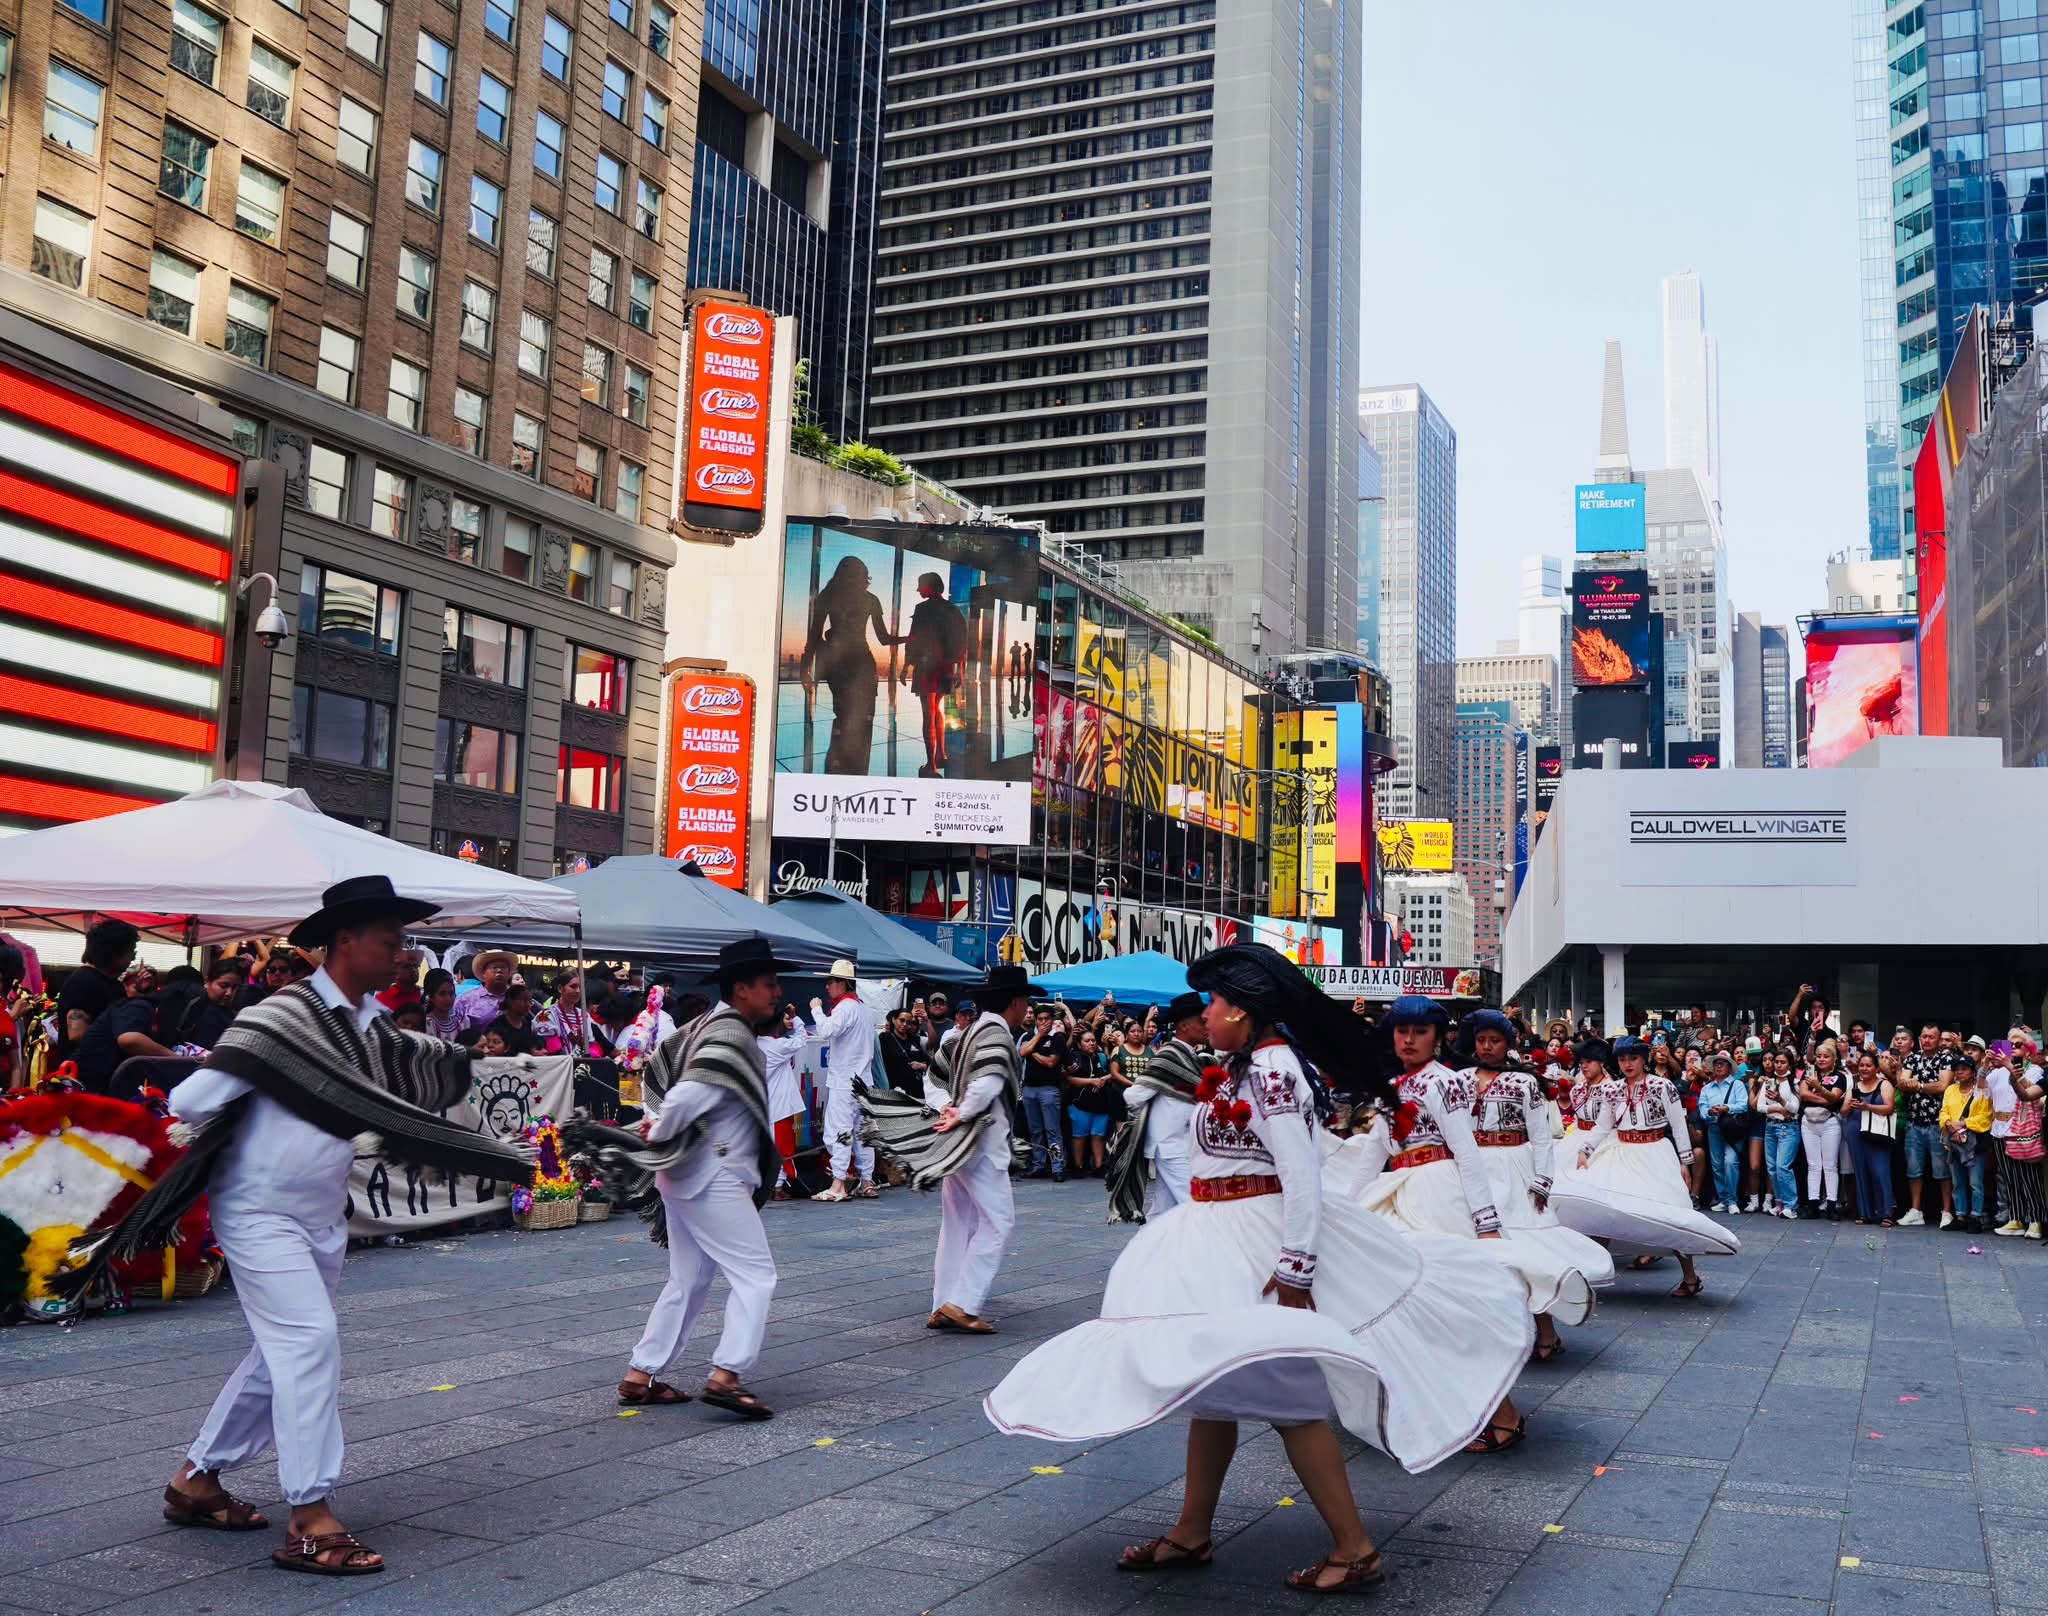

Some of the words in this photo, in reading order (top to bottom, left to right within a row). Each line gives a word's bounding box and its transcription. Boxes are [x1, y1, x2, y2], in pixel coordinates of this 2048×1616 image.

[707, 313, 761, 338] Cane's
[705, 352, 759, 370] GLOBAL
[704, 364, 759, 380] FLAGSHIP
[702, 388, 757, 412] Cane's
[700, 427, 755, 446] GLOBAL
[699, 440, 755, 456] FLAGSHIP
[699, 464, 754, 489] Cane's
[1580, 490, 1605, 500] MAKE
[1580, 499, 1635, 509] RETIREMENT
[1578, 593, 1641, 603] ILLUMINATED
[685, 685, 742, 712] Cane's
[683, 727, 740, 743] GLOBAL
[682, 740, 740, 754] FLAGSHIP
[1584, 743, 1638, 754] SAMNG
[681, 764, 738, 792] Cane's
[1172, 731, 1212, 794] LION
[1214, 752, 1252, 811] KING
[935, 791, 963, 800] STEPS
[964, 792, 988, 801] AWAY
[990, 793, 1001, 801] AT
[934, 801, 946, 809] 45
[957, 801, 979, 810] 42nd
[980, 802, 992, 811] St.
[679, 807, 736, 822] GLOBAL
[934, 812, 952, 821] BUY
[954, 813, 991, 823] TICKETS
[992, 815, 1003, 823] AT
[678, 821, 736, 833] FLAGSHIP
[934, 822, 1004, 833] SUMMITOV.COM
